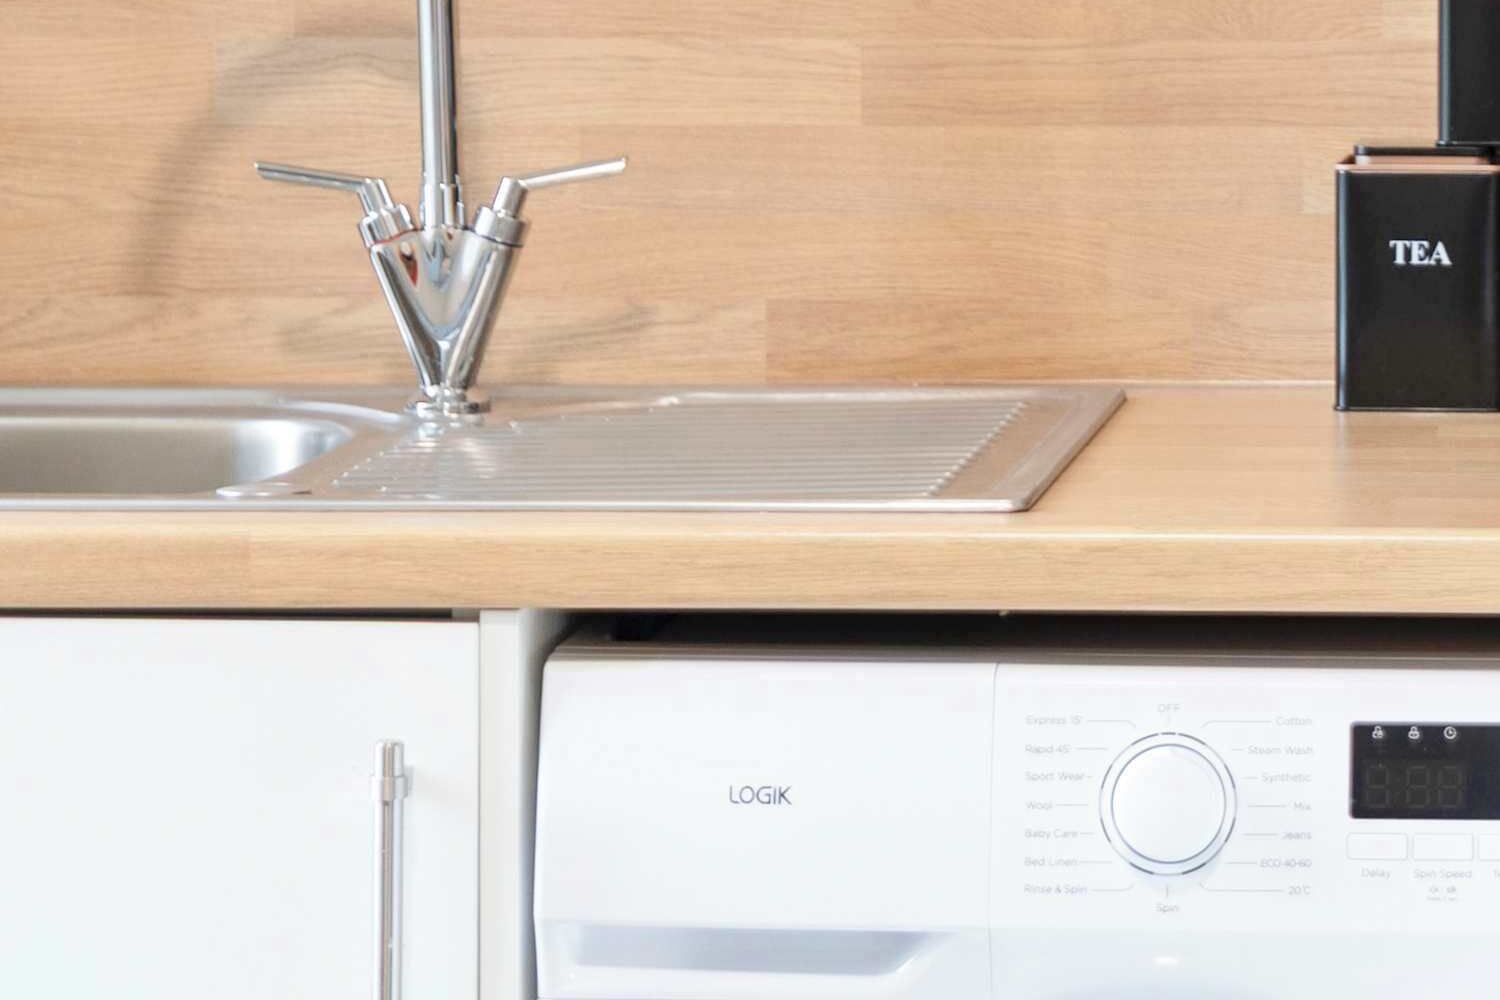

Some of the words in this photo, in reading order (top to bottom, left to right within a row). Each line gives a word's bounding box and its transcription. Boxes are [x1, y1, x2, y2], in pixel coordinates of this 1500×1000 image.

[1389, 240, 1452, 265] TEA
[1158, 704, 1181, 713] OFF
[1025, 715, 1067, 727] Express
[1275, 717, 1313, 726] Cotton
[1025, 744, 1053, 755] Rapid
[1248, 745, 1281, 755] Steam
[1285, 745, 1313, 755] Wash
[1025, 771, 1055, 782] Sport
[1058, 772, 1085, 781] Wear
[1262, 773, 1312, 784] Synthetic
[728, 785, 793, 805] LOGIK
[1025, 801, 1053, 810] Wool
[1293, 802, 1311, 811] Mix
[1024, 829, 1051, 840] Baby
[1053, 829, 1078, 838] Care
[1282, 831, 1312, 840] Jeans
[1024, 857, 1046, 866] Bed
[1048, 857, 1078, 866] Linen
[1361, 868, 1391, 880] Delay
[1413, 869, 1437, 880] Spin
[1440, 869, 1473, 880] Speed
[1024, 885, 1052, 895] Rinse
[1064, 885, 1088, 896] Spin
[1156, 903, 1179, 914] Spin
